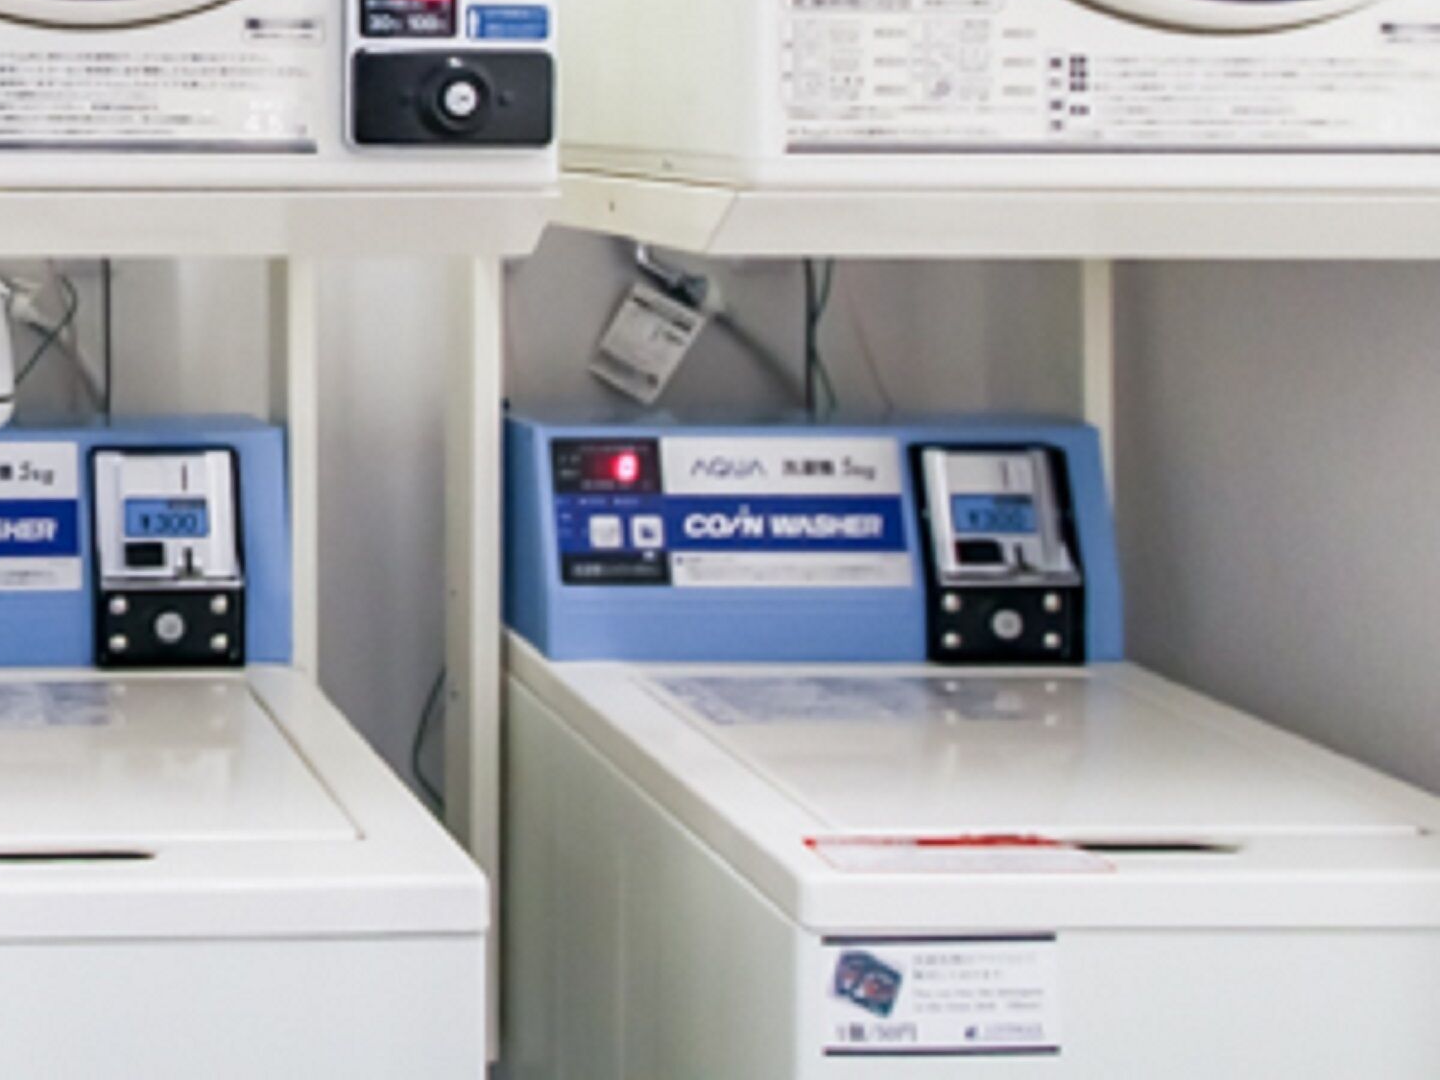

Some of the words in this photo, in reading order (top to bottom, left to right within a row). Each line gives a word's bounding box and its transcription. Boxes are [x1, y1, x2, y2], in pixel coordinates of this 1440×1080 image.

[690, 455, 767, 479] AQUA
[684, 504, 765, 538] COIN
[770, 513, 884, 538] WASHER
